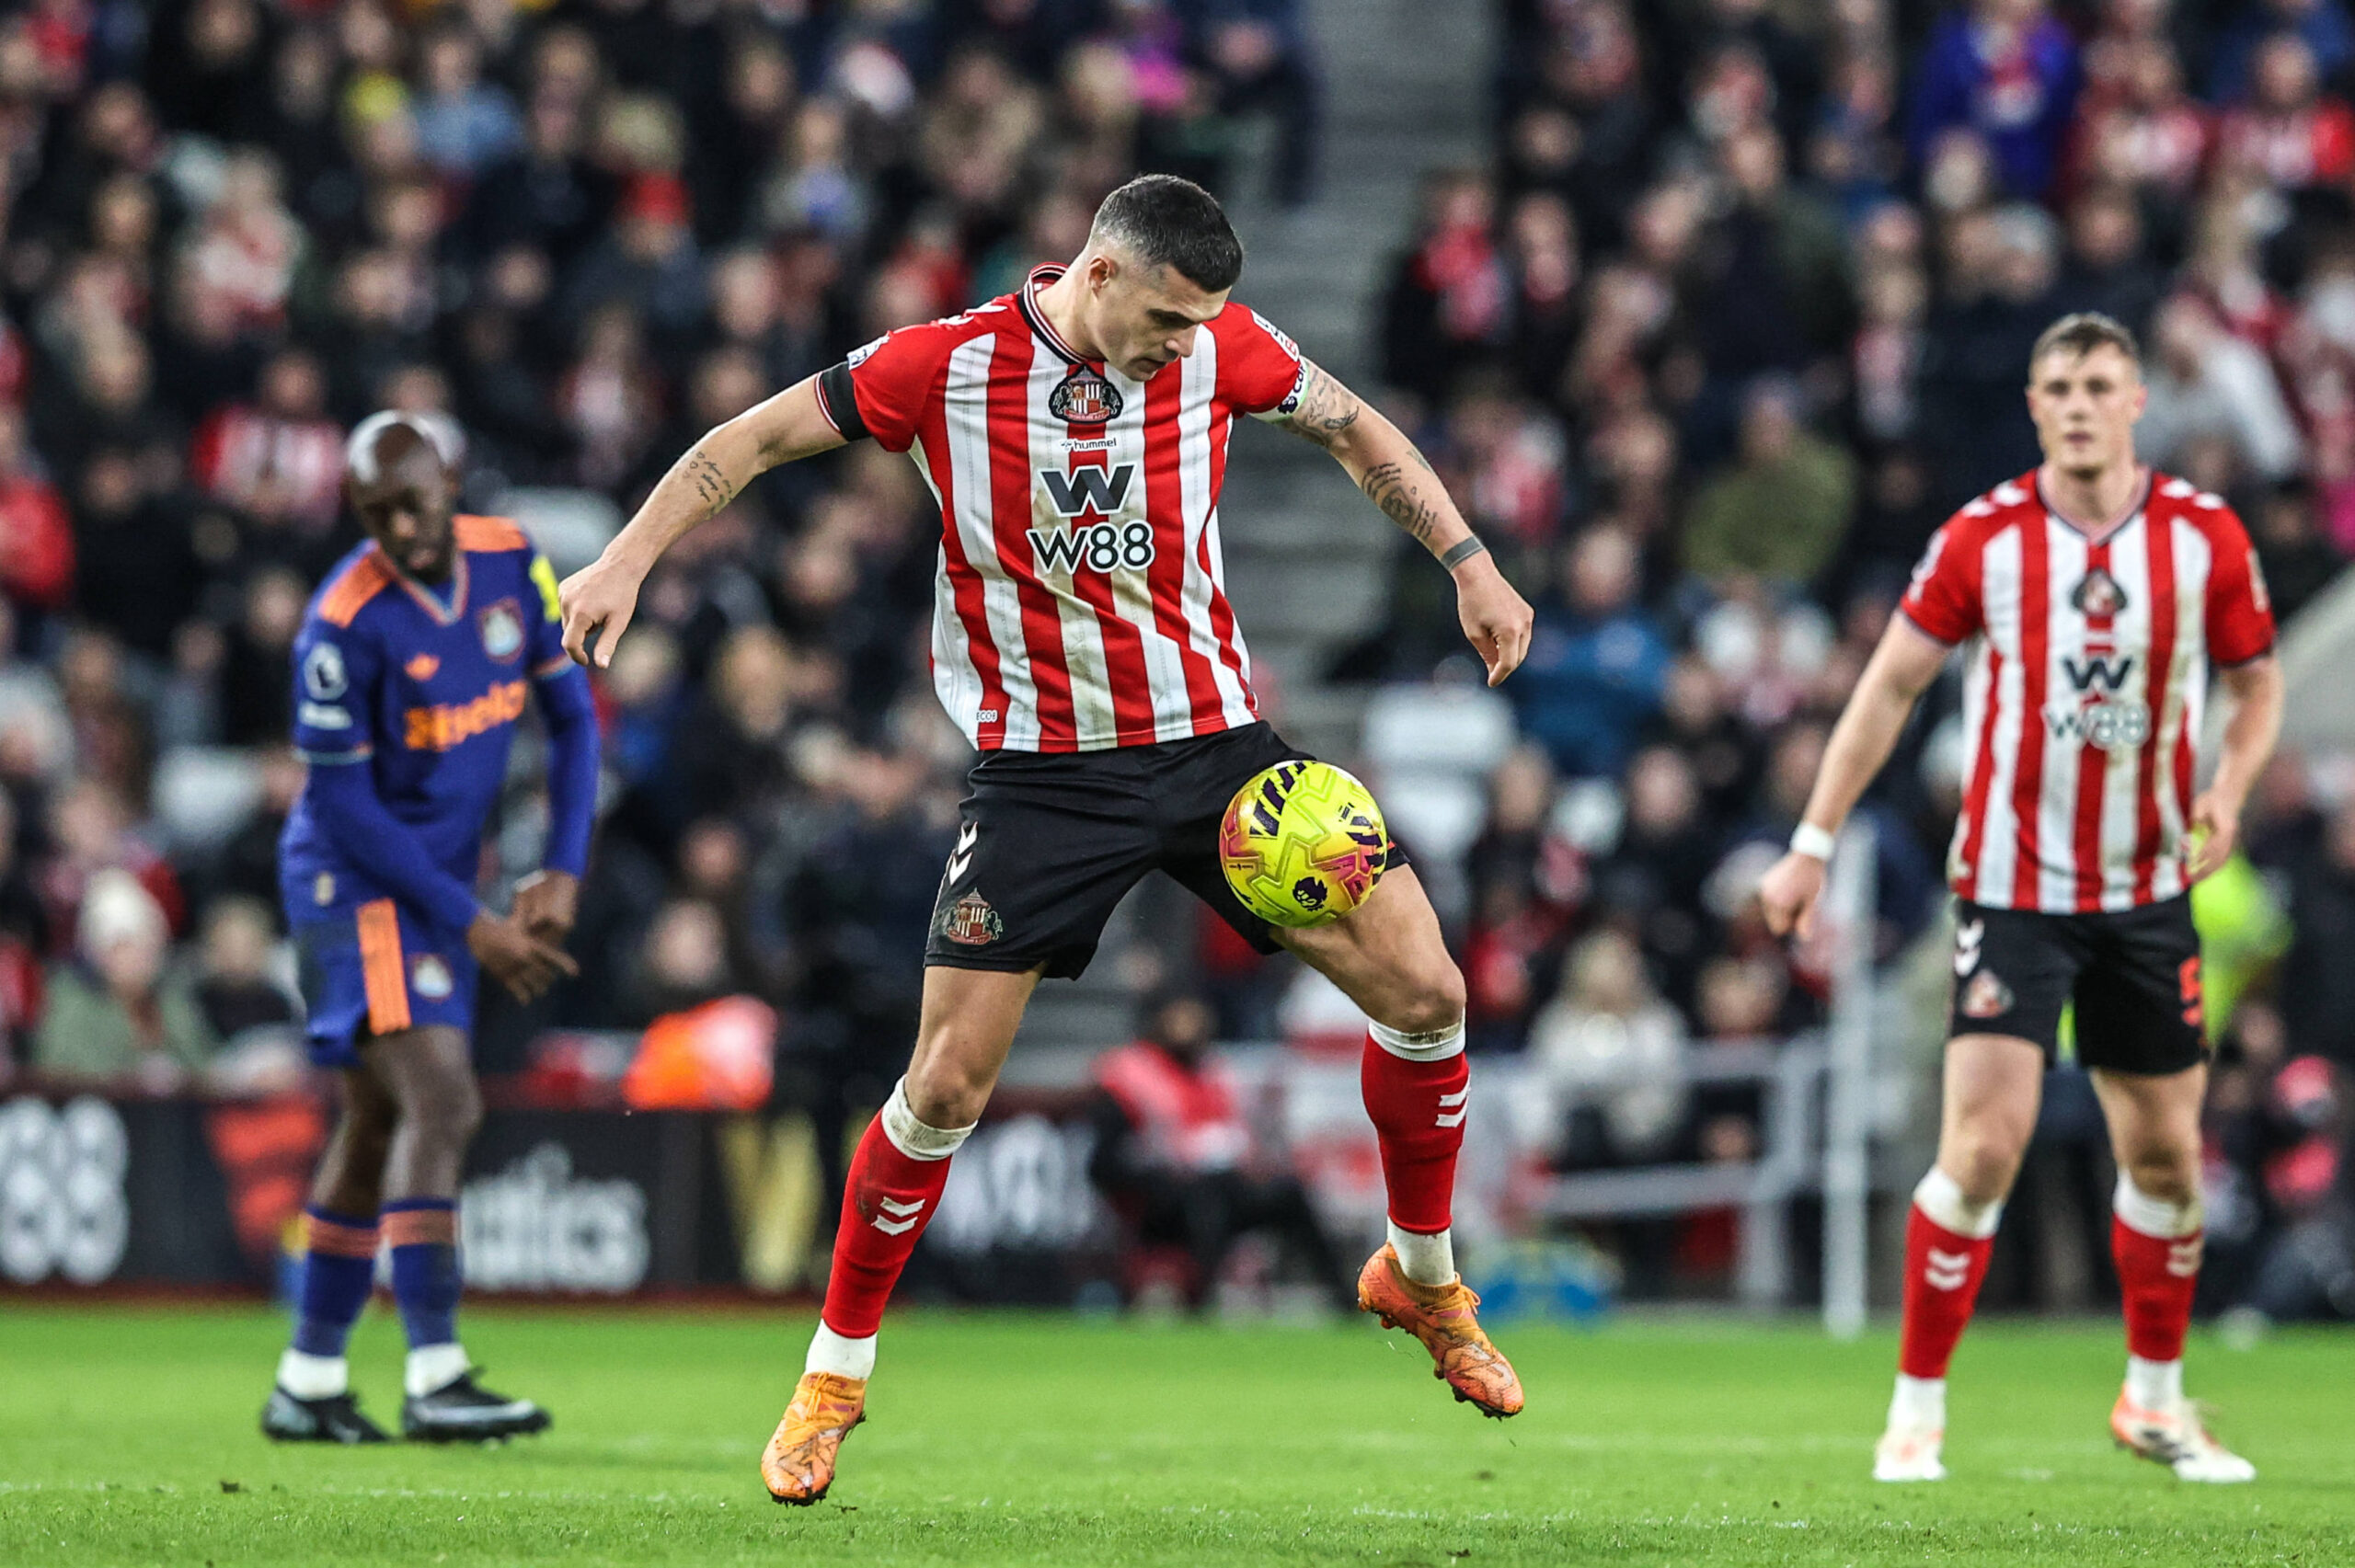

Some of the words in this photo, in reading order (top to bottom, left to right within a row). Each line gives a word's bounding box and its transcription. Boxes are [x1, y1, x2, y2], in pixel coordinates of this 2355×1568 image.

[1074, 438, 1117, 450] hummel
[1040, 464, 1135, 515] W
[1028, 521, 1154, 571] W88
[2062, 655, 2133, 692] W
